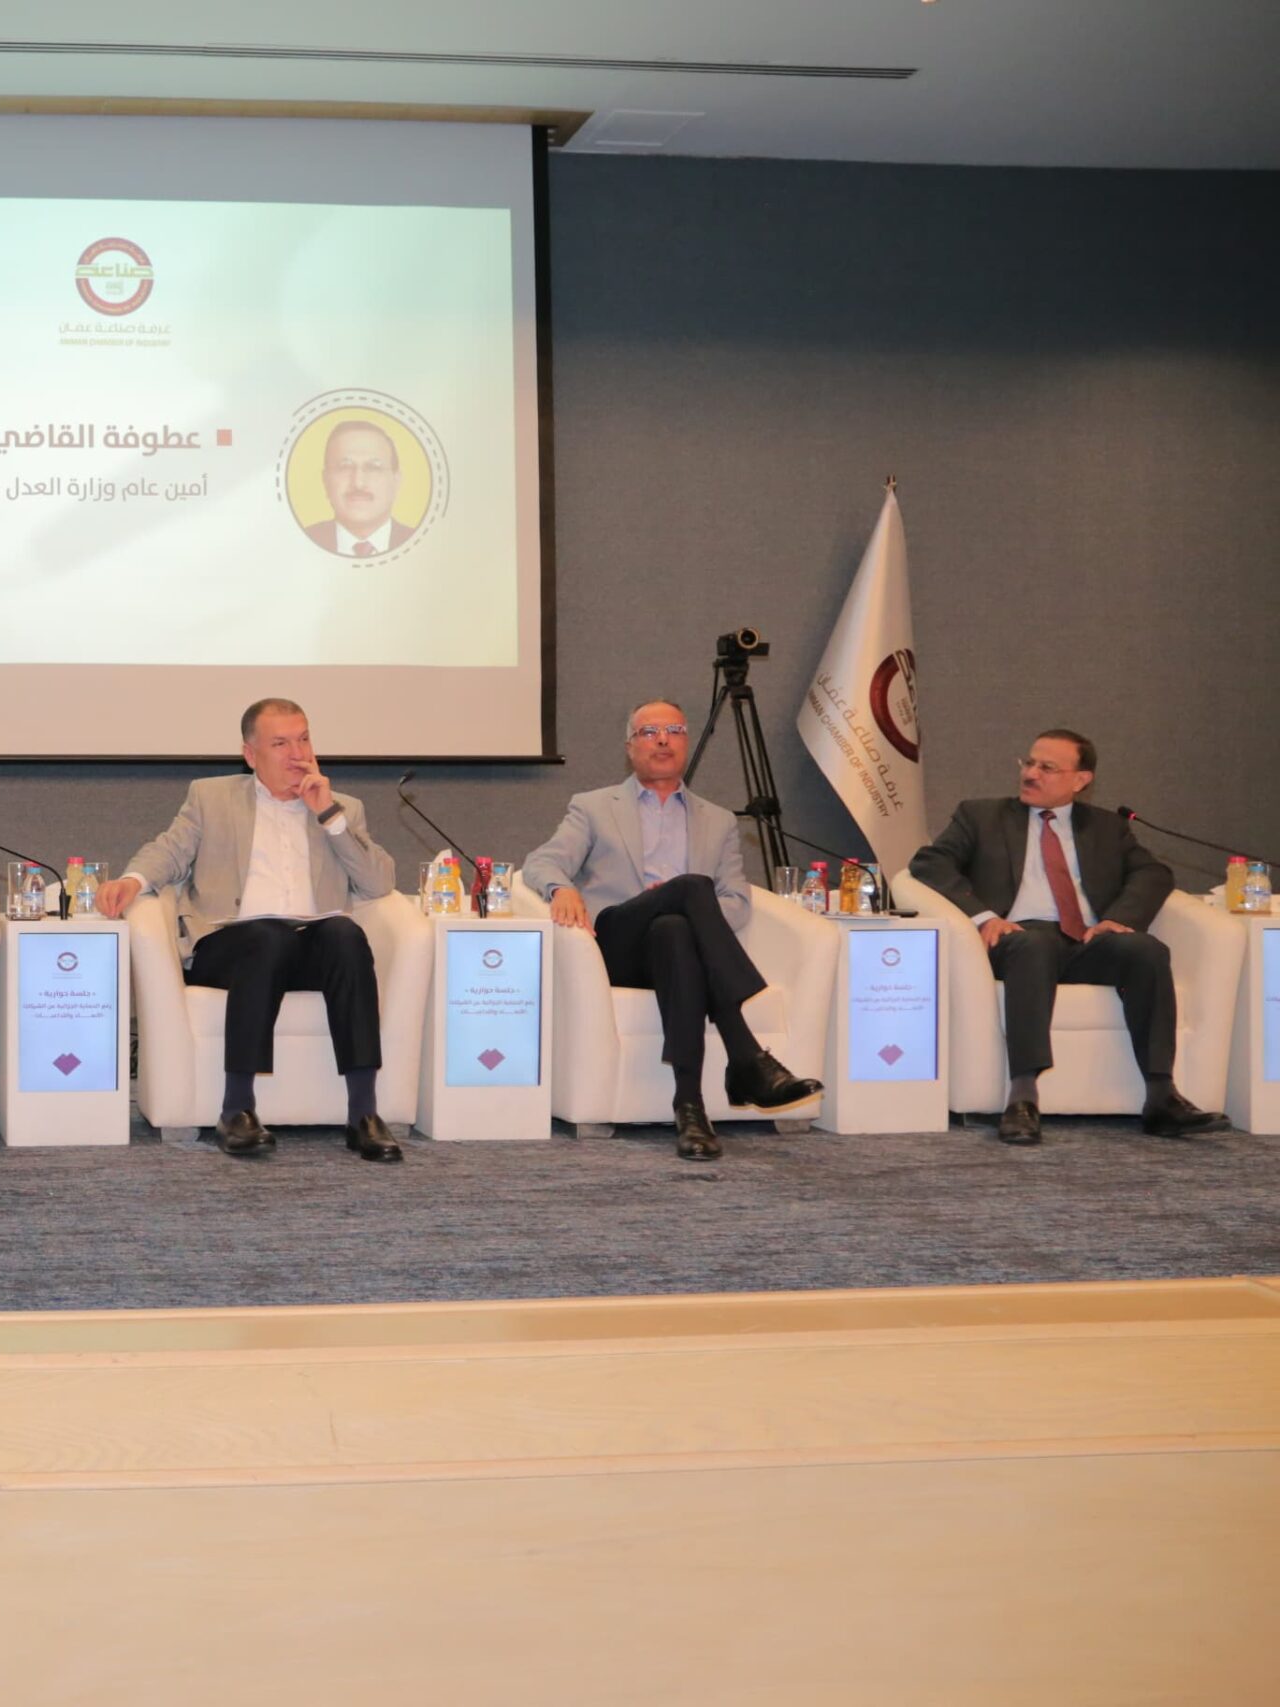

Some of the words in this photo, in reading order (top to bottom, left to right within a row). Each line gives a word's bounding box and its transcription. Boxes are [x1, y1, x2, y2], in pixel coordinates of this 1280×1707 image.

[103, 424, 202, 456] عطوفة
[5, 477, 61, 501] العدل
[67, 478, 117, 502] وزارة
[121, 477, 159, 502] عام
[165, 473, 209, 502] أمين
[842, 708, 881, 763] صناعة
[821, 715, 855, 761] CHAMBER
[849, 756, 864, 773] OF
[858, 766, 890, 817] INDUSTRY
[877, 763, 904, 811] غرفة
